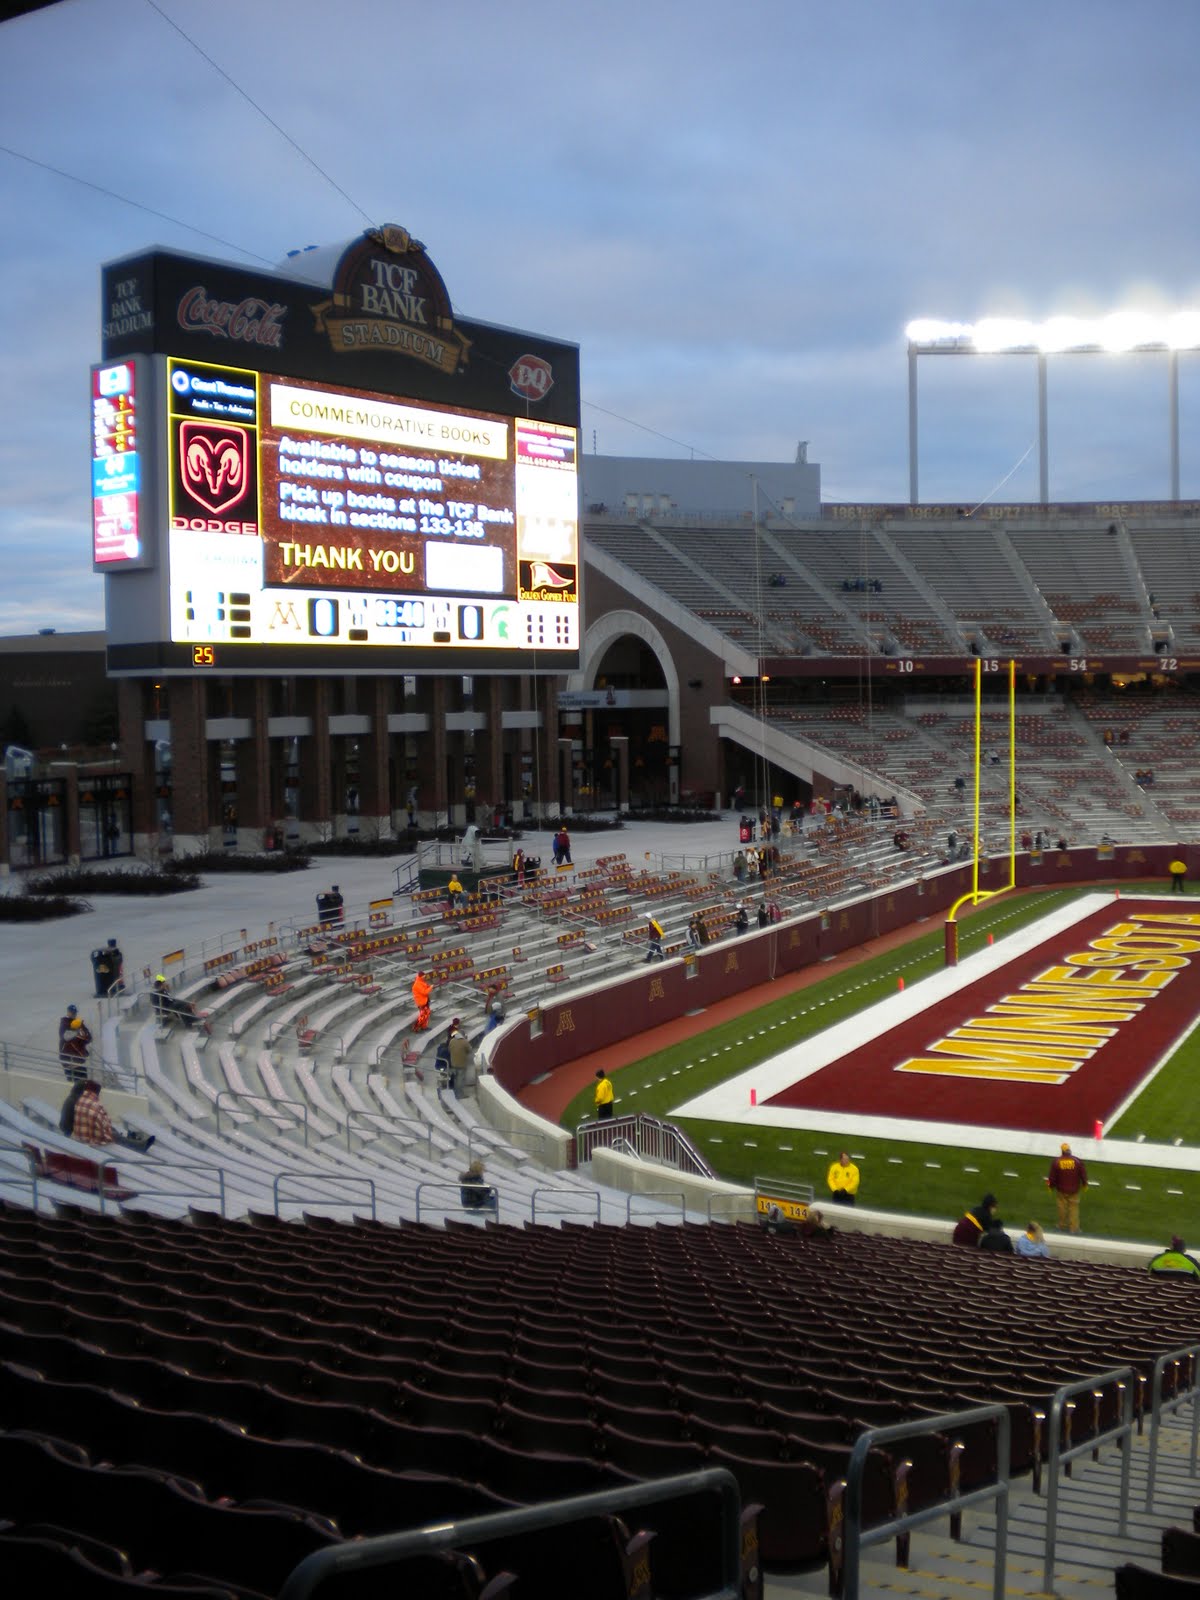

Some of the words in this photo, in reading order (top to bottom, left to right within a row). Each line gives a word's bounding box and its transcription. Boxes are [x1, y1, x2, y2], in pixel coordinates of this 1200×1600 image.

[116, 278, 137, 298] TCF
[371, 260, 417, 294] TCF
[111, 297, 142, 319] BANK
[177, 286, 287, 347] Coca-Cola
[361, 284, 427, 325] BANK
[103, 311, 153, 338] STADIUM
[342, 324, 444, 364] STADIUM
[516, 364, 547, 391] DQ
[290, 401, 434, 437] COMMEMORATIVE
[441, 426, 491, 446] BOOKS
[279, 436, 357, 463] Available
[360, 448, 377, 465] to
[379, 452, 436, 472] season
[438, 459, 481, 479] ticket
[279, 455, 344, 480] holders
[347, 465, 382, 484] with
[384, 471, 443, 492] coupon
[279, 482, 318, 503] Pick
[321, 489, 344, 508] up
[346, 490, 396, 511] books
[399, 499, 416, 513] at
[418, 498, 444, 516] the
[446, 501, 475, 519] TCF
[477, 504, 514, 524] Bank
[279, 502, 328, 524] kiosk
[330, 506, 347, 525] in
[349, 510, 417, 532] sections
[172, 517, 257, 536] DODGE
[278, 542, 363, 571] THANK
[367, 549, 415, 573] YOU
[315, 598, 333, 635] 0
[463, 605, 479, 639] 0
[194, 646, 213, 663] 25
[898, 660, 913, 673] 10
[983, 660, 999, 672] 15
[1070, 659, 1087, 671] 54
[1160, 658, 1178, 670] 72
[790, 1206, 808, 1218] 144
